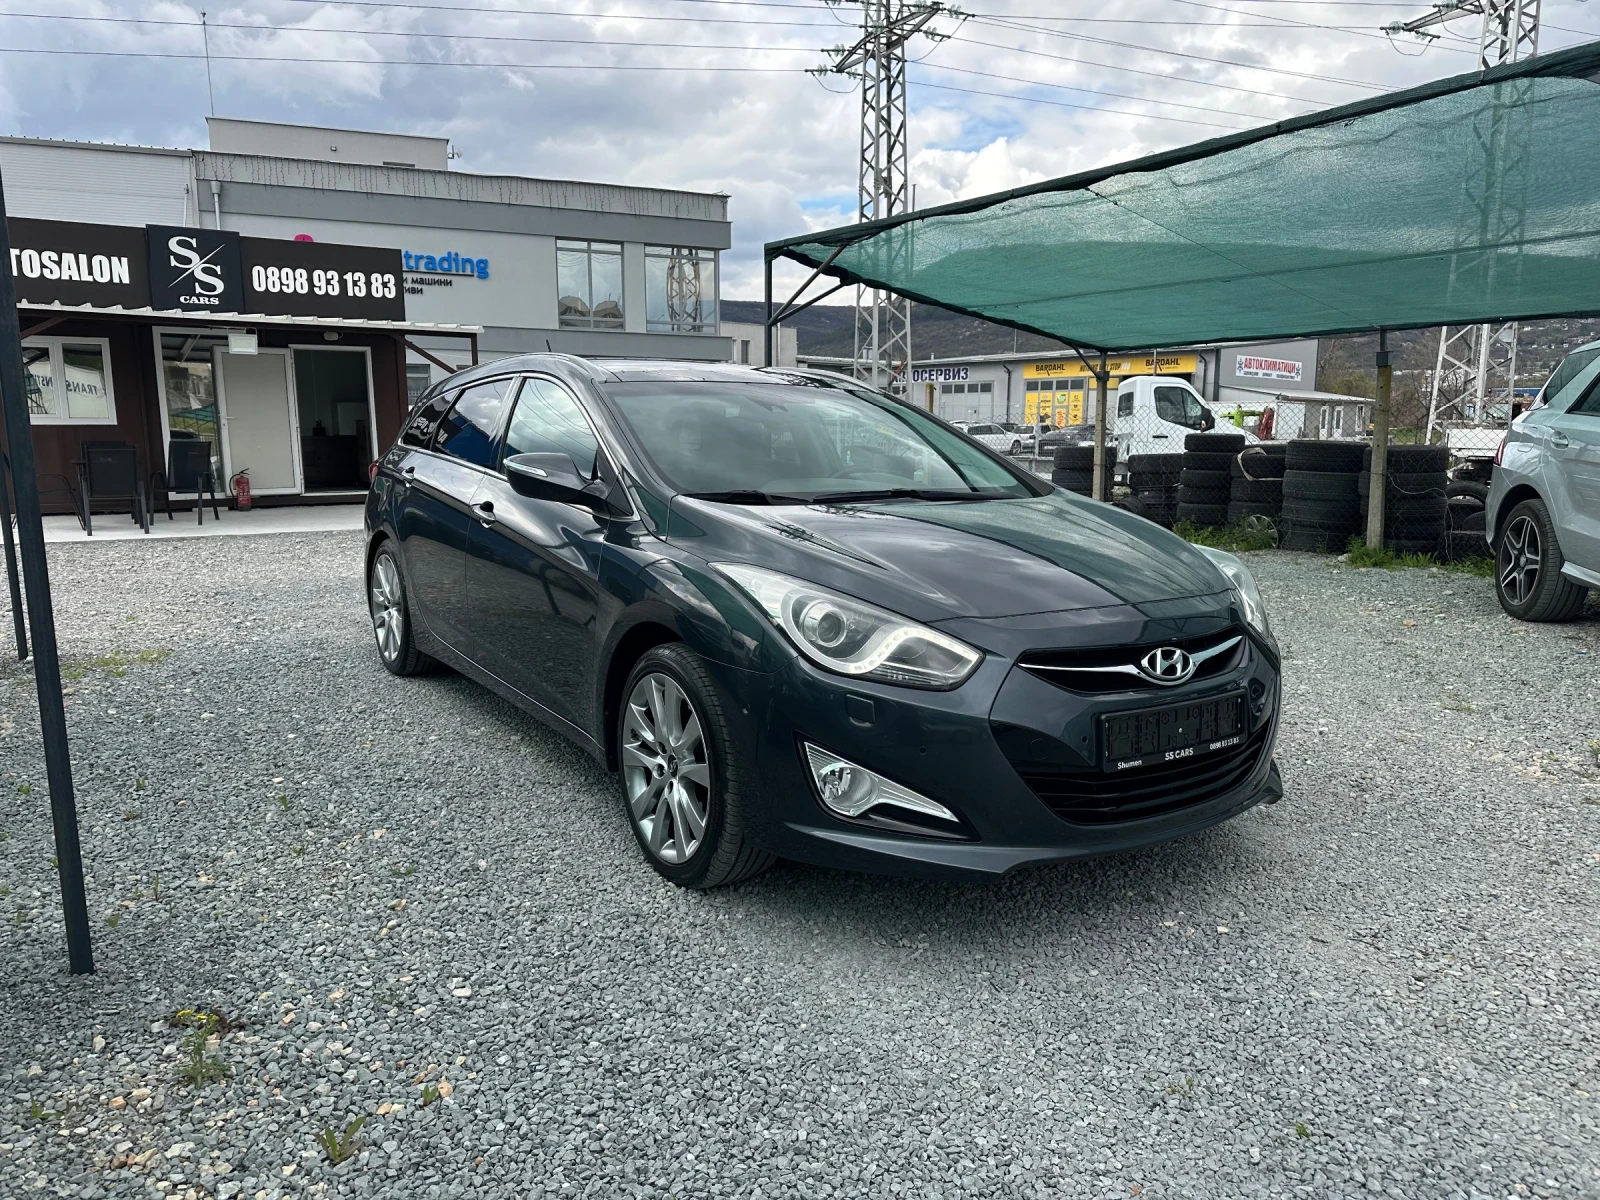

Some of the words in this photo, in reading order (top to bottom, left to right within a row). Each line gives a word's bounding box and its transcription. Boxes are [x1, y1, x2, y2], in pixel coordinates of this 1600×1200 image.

[403, 250, 489, 280] trading
[252, 265, 309, 294] 0898
[312, 269, 340, 296] 93
[343, 271, 367, 297] 13
[370, 273, 396, 299] 83
[411, 276, 453, 287] машини
[179, 295, 220, 305] CARS
[1035, 363, 1066, 375] BARDAHL
[1145, 357, 1181, 370] BARDAHL
[1175, 747, 1194, 759] CARS
[1118, 760, 1142, 770] Shumen
